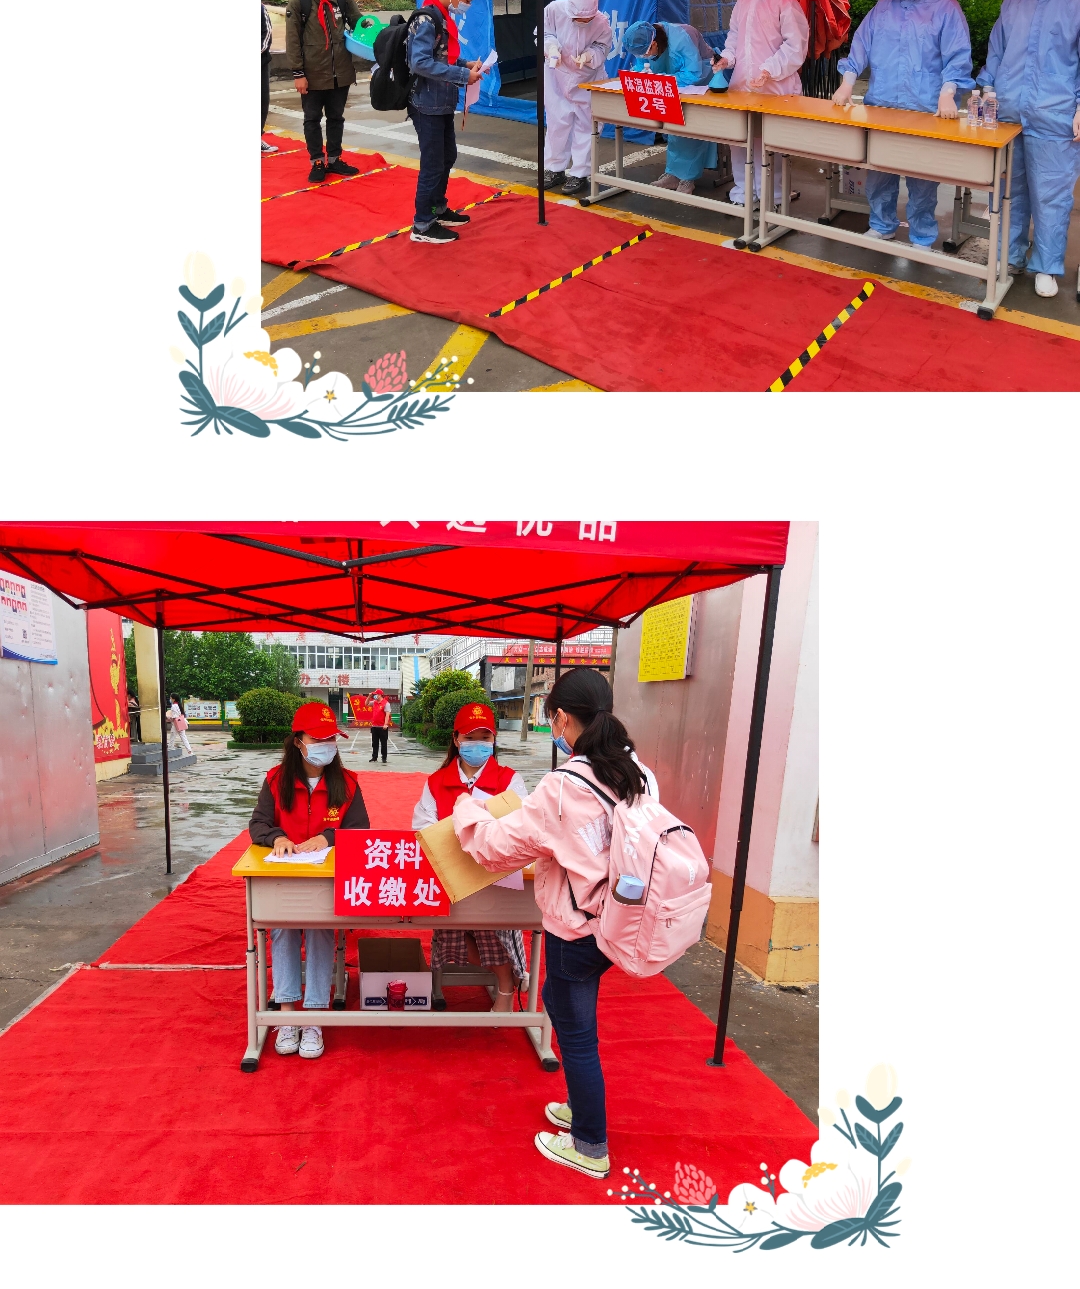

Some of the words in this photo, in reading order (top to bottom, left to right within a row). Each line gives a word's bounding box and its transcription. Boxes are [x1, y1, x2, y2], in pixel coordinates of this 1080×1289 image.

[624, 76, 675, 98] 体温监测点
[638, 97, 667, 115] 2号
[300, 673, 350, 686] 办公楼
[364, 838, 423, 870] 资料
[343, 876, 442, 907] 收缴处
